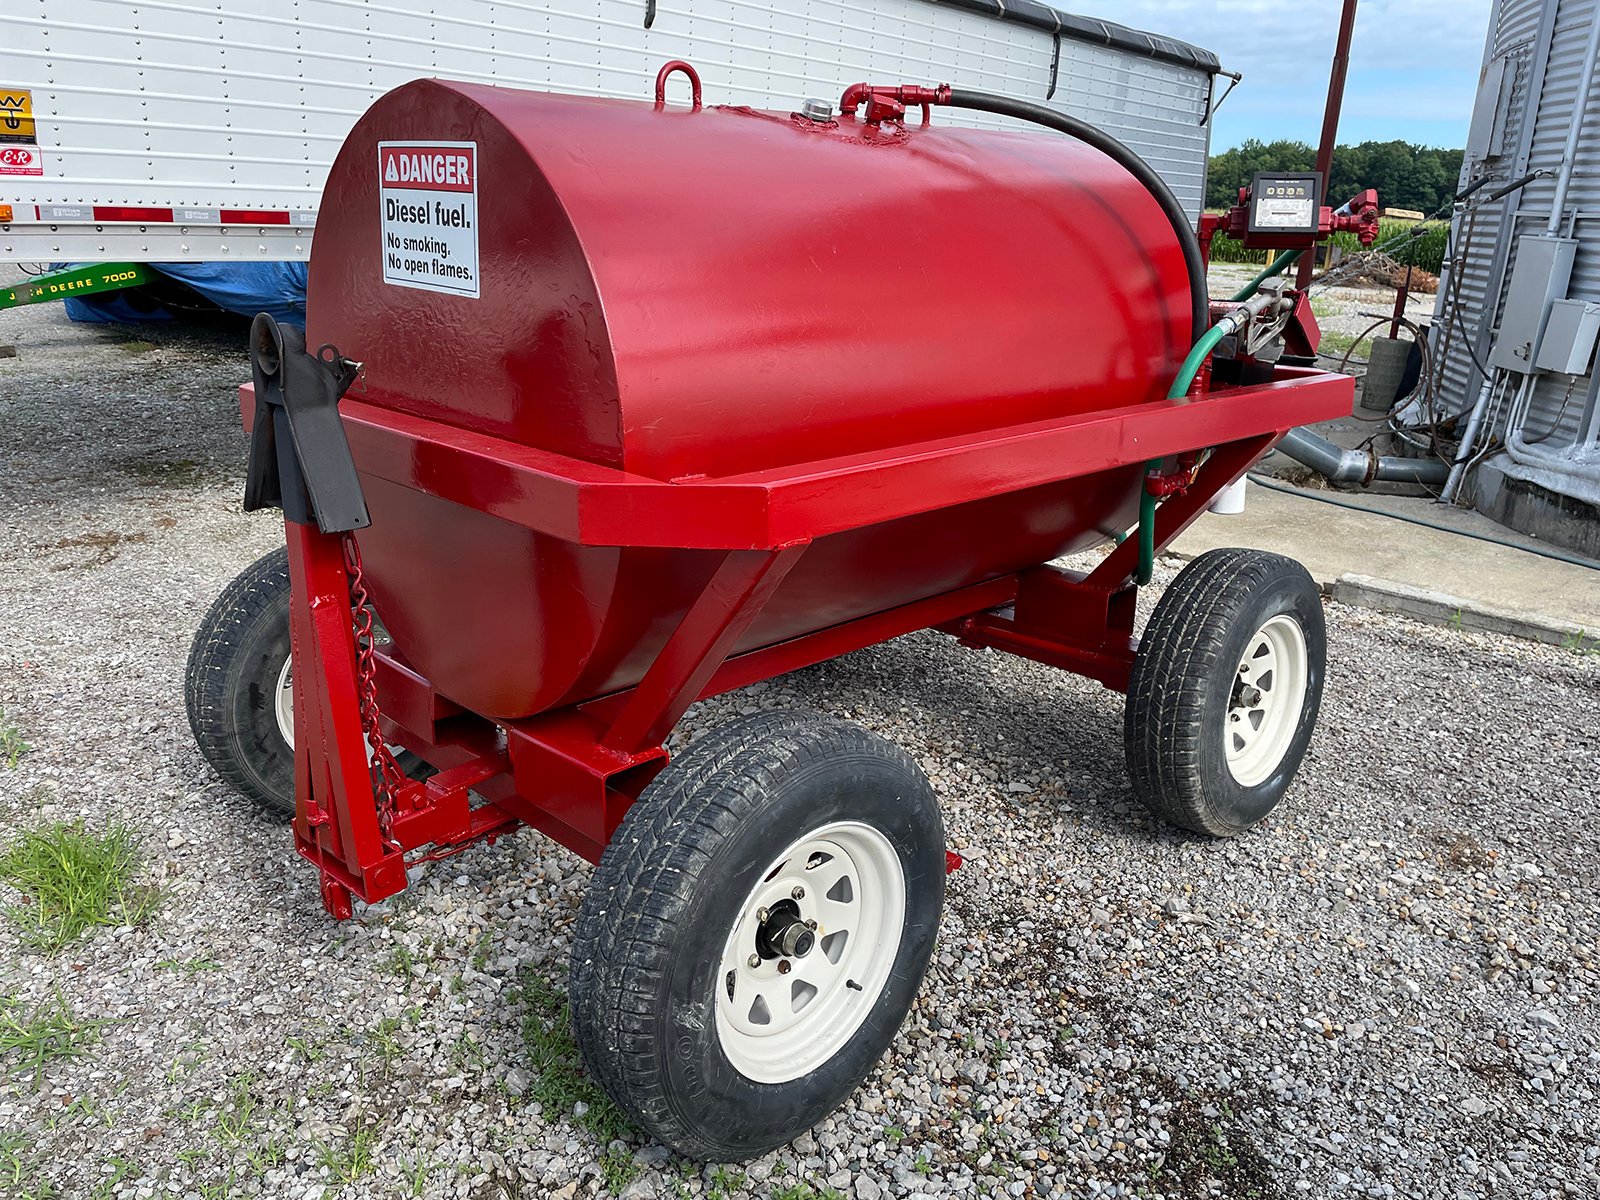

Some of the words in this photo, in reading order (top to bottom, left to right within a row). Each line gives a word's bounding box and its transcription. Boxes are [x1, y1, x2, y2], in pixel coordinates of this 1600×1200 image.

[3, 150, 28, 164] E&R
[399, 154, 470, 185] DANGER
[386, 198, 431, 225] Diesel
[435, 201, 471, 229] fuel.
[387, 232, 401, 249] No
[403, 236, 451, 259] smoking.
[388, 252, 402, 270] No
[404, 258, 429, 275] open
[432, 259, 473, 281] flames.
[50, 278, 93, 293] DEERE
[102, 271, 137, 284] 7000
